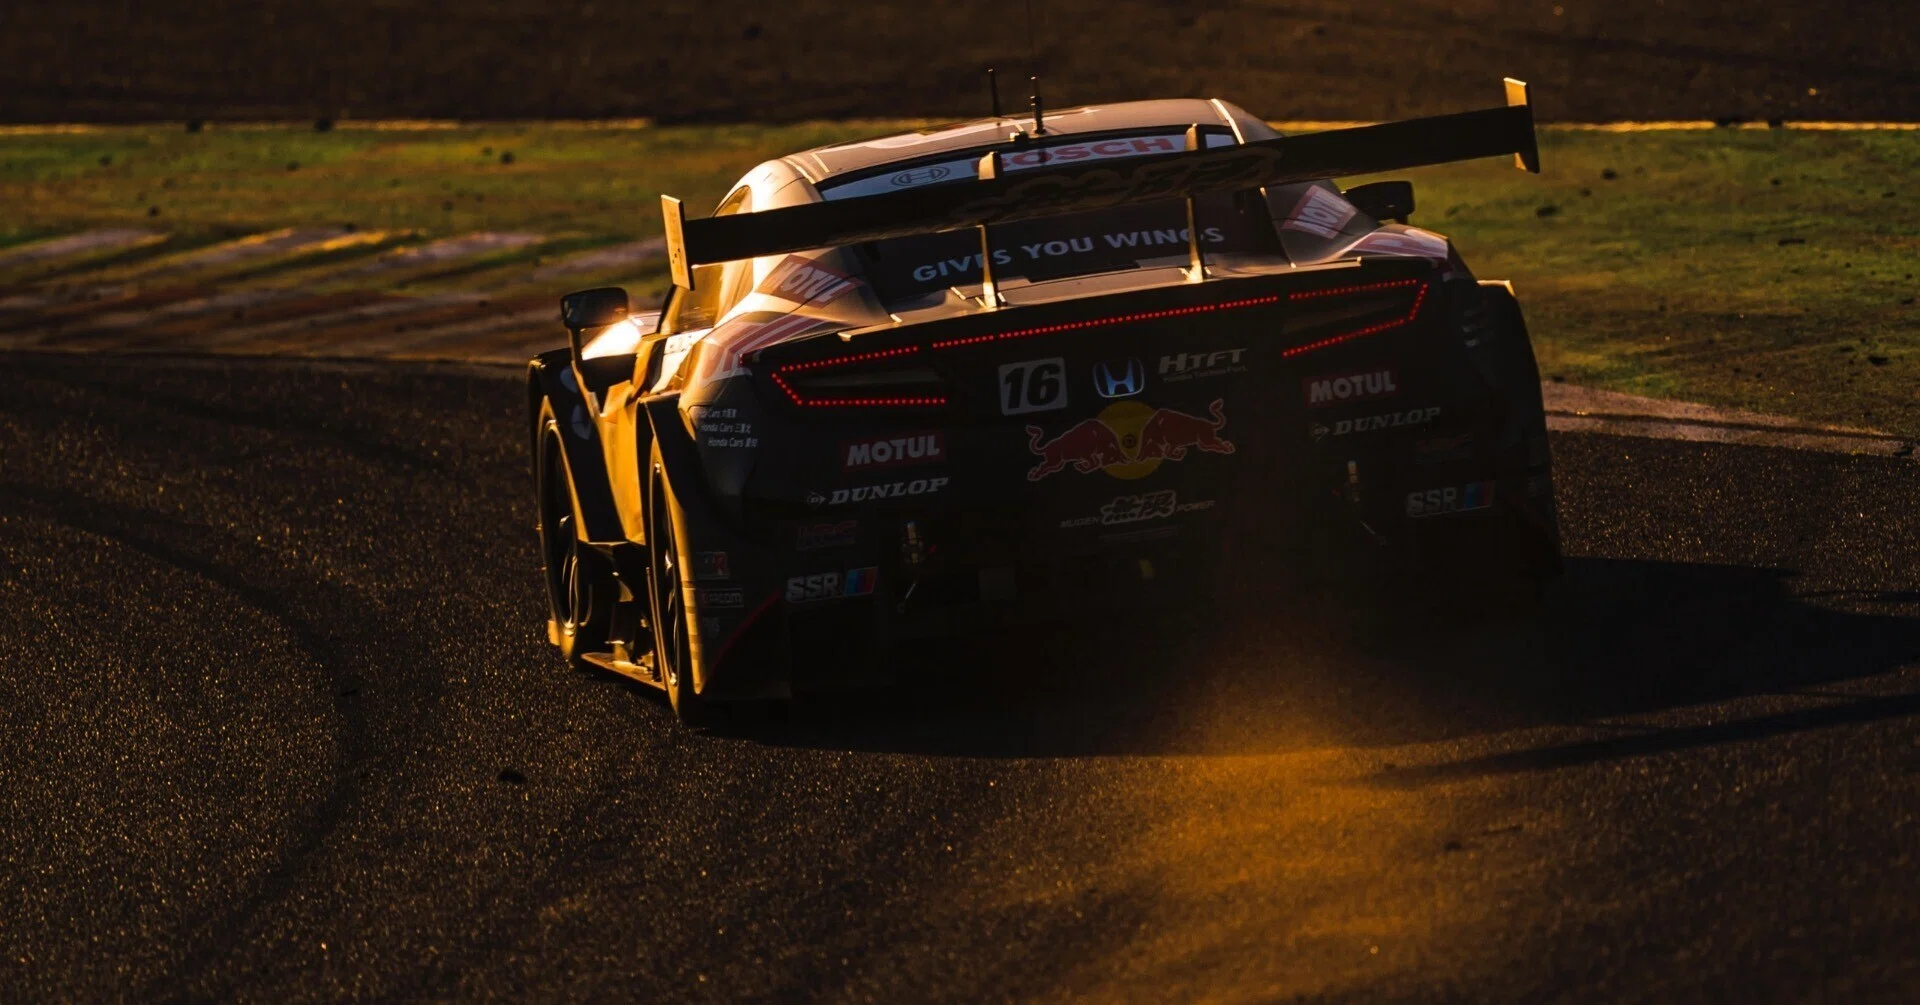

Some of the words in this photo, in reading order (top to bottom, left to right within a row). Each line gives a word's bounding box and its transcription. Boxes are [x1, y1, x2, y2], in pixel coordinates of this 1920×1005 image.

[1021, 236, 1095, 260] YOU
[1158, 348, 1248, 374] HTFT
[1003, 363, 1061, 409] 16
[1310, 371, 1396, 404] MOTUL
[1333, 406, 1441, 436] DUNLOP
[847, 435, 940, 467] MOTUL
[828, 477, 949, 505] DUNLOP
[1407, 487, 1458, 515] SSR
[786, 572, 842, 602] SSR
